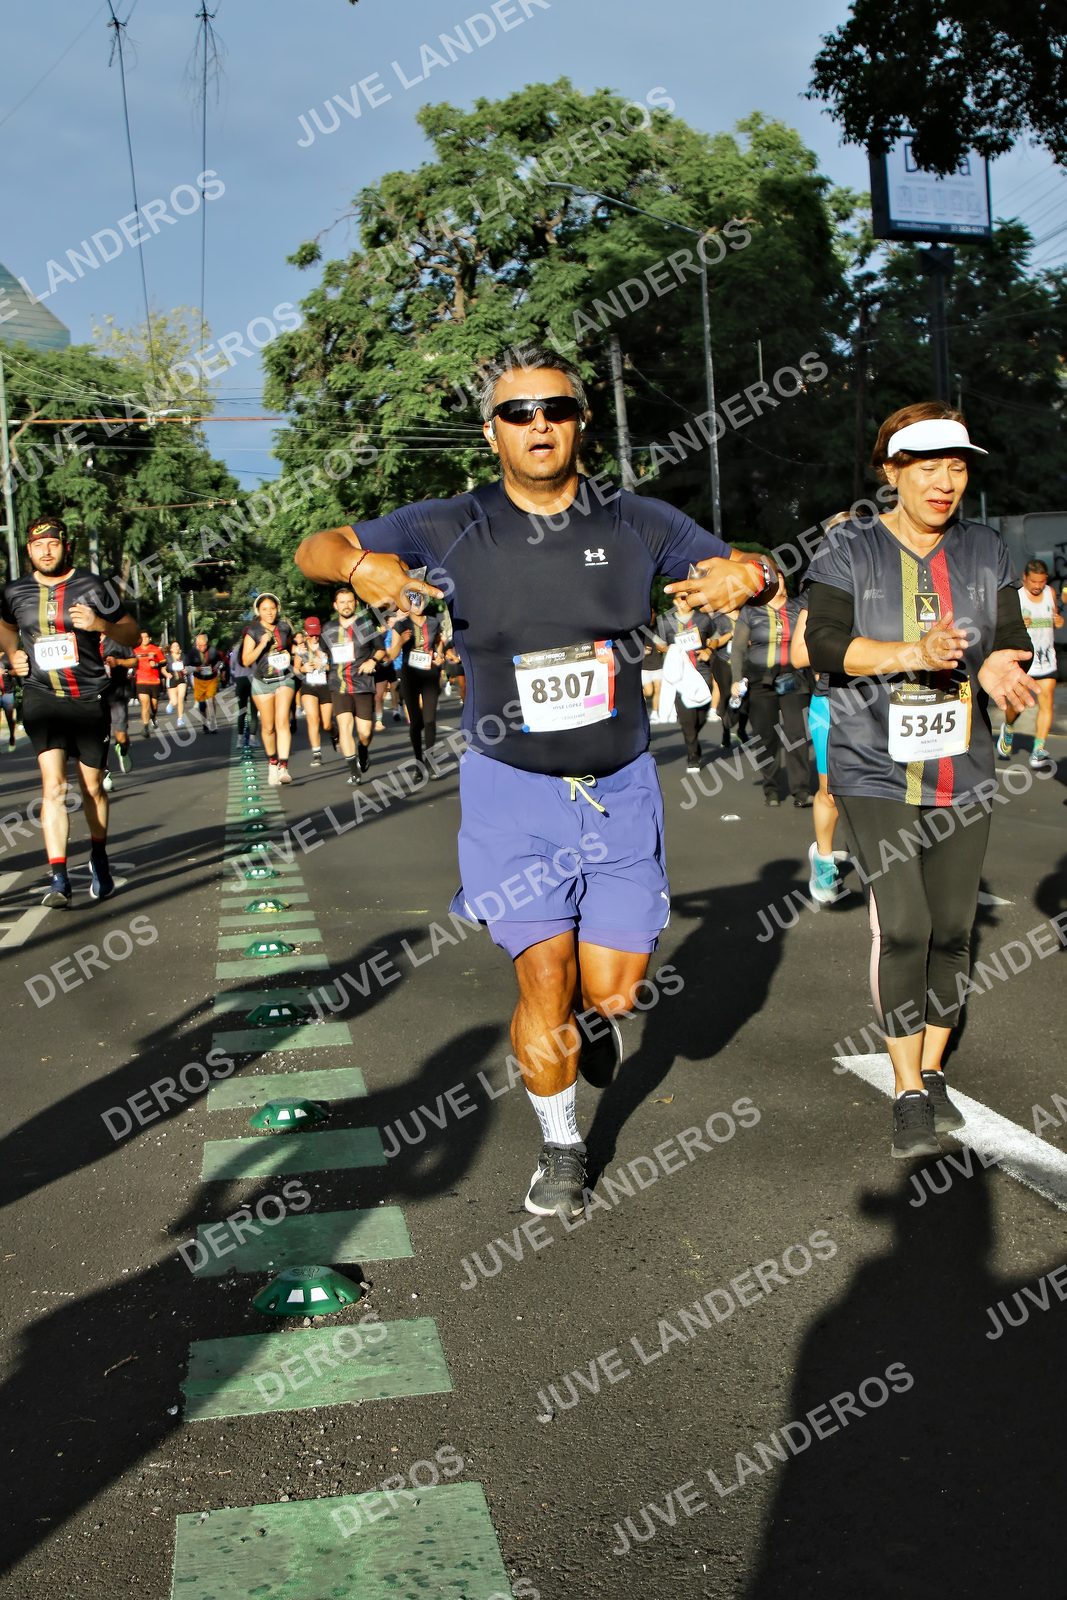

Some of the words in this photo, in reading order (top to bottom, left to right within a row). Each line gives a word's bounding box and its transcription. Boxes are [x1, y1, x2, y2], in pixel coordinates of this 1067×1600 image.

[41, 645, 67, 657] 8019
[531, 670, 594, 703] 8307
[900, 710, 955, 737] 5345
